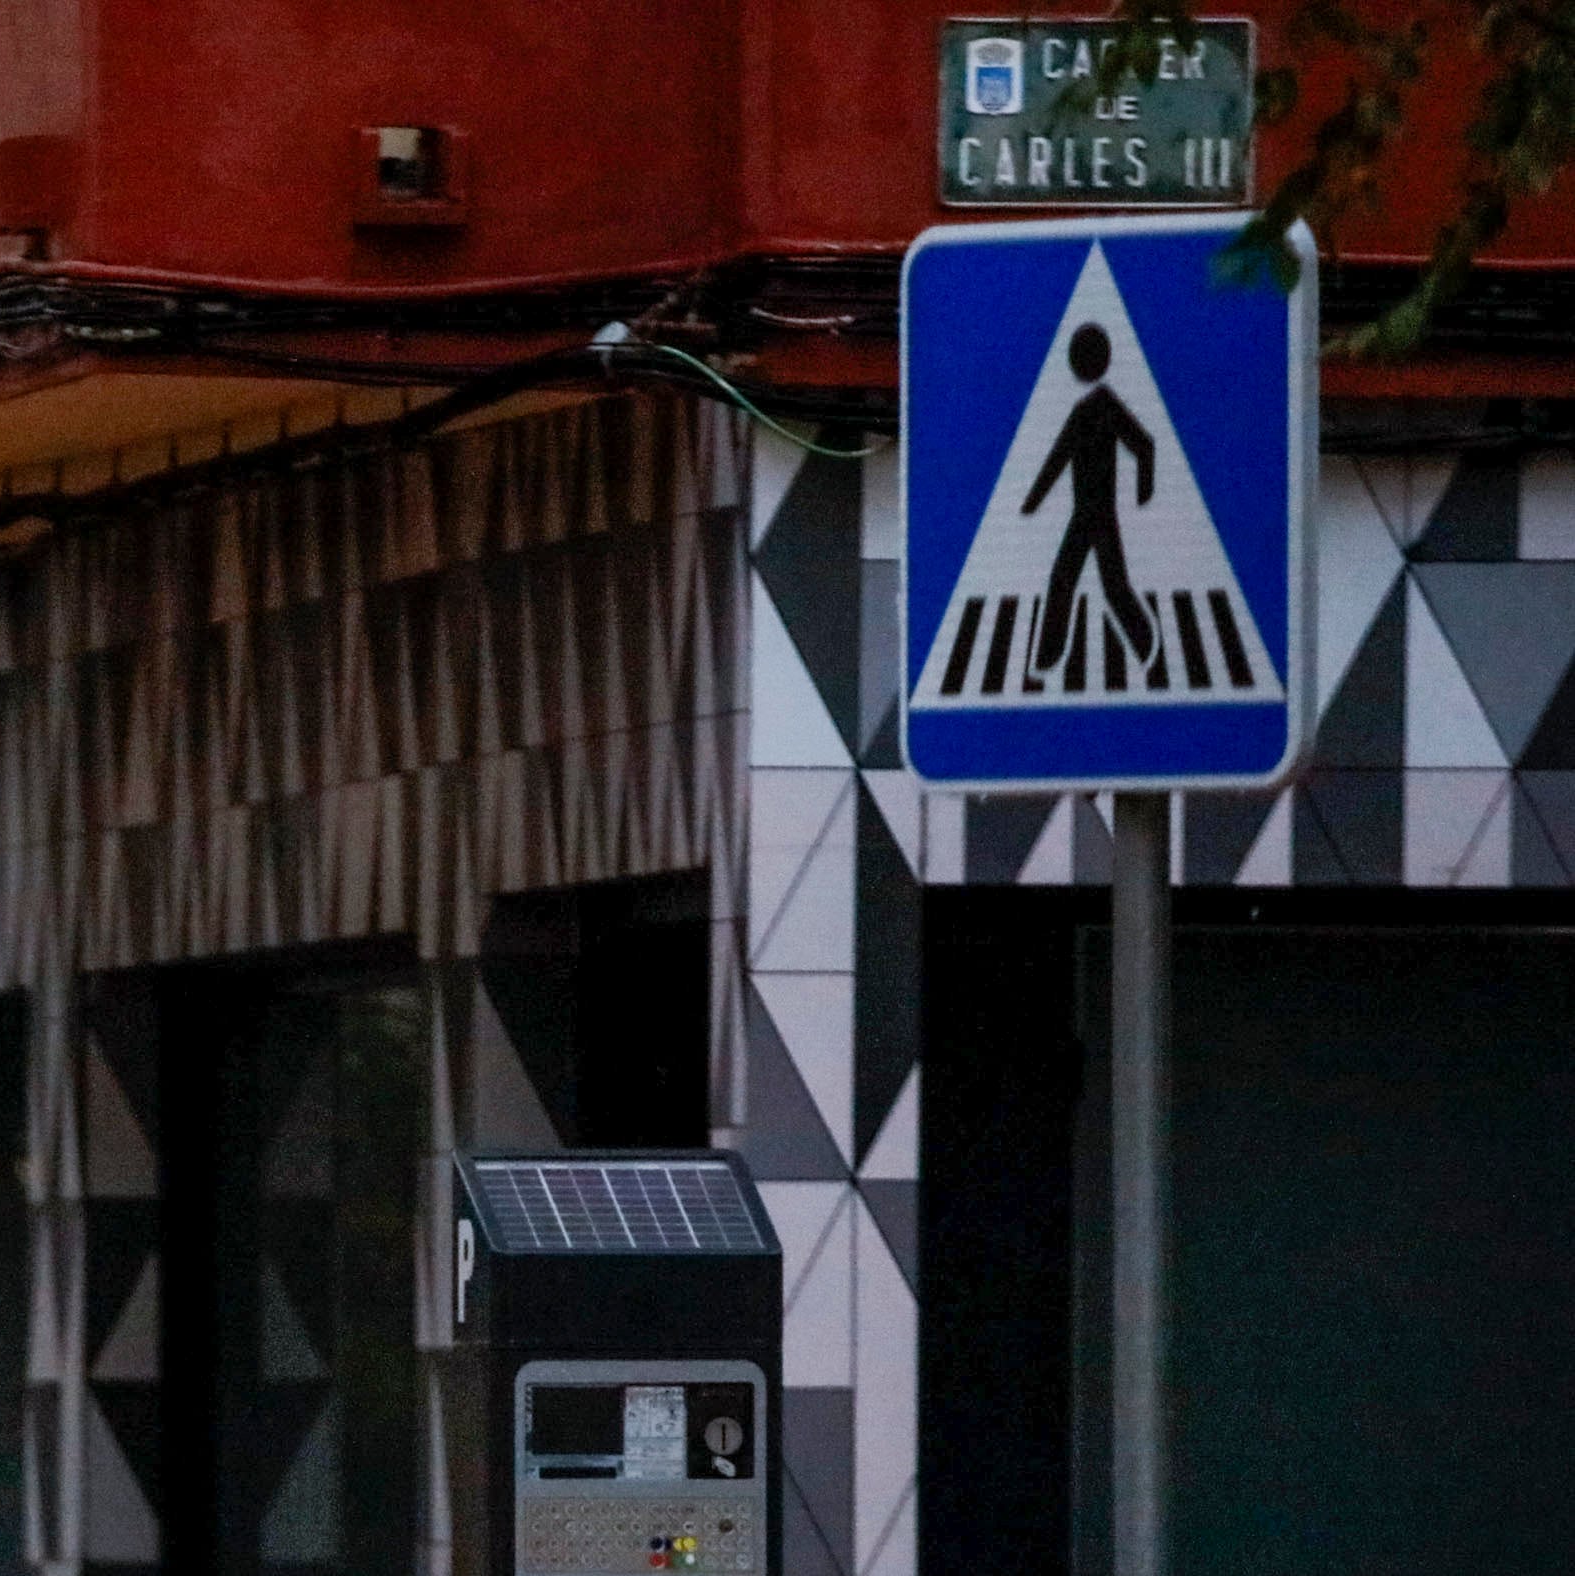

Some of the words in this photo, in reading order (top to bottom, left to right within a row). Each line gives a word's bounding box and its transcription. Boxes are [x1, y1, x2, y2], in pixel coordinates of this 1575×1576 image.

[1042, 38, 1206, 80] CAER
[1095, 95, 1140, 120] DE
[958, 136, 1148, 188] CARLES
[1184, 137, 1231, 188] III
